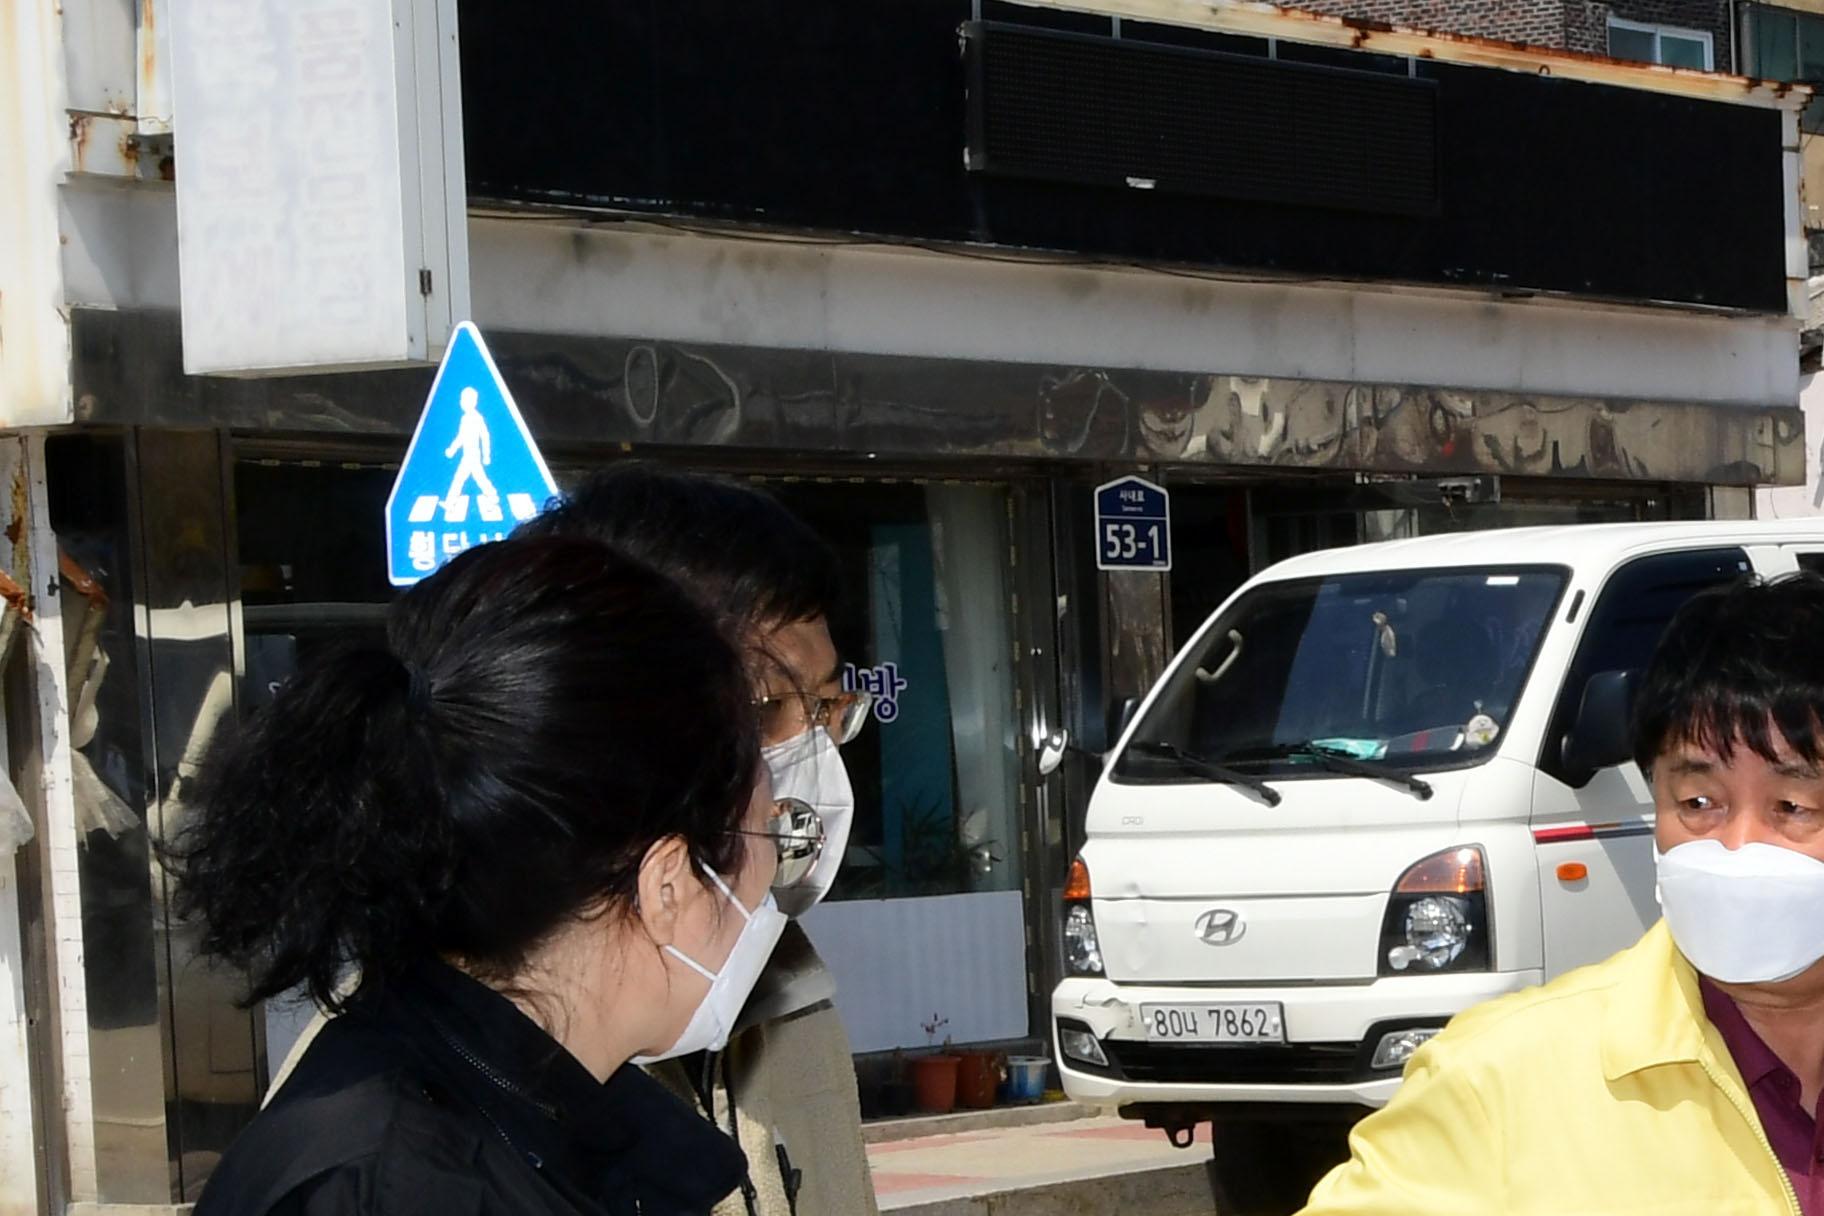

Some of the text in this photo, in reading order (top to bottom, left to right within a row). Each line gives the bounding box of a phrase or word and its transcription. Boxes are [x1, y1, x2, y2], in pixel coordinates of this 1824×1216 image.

[408, 531, 502, 571] 횡단
[1106, 524, 1160, 559] 53-1
[1207, 1008, 1270, 1037] 7862
